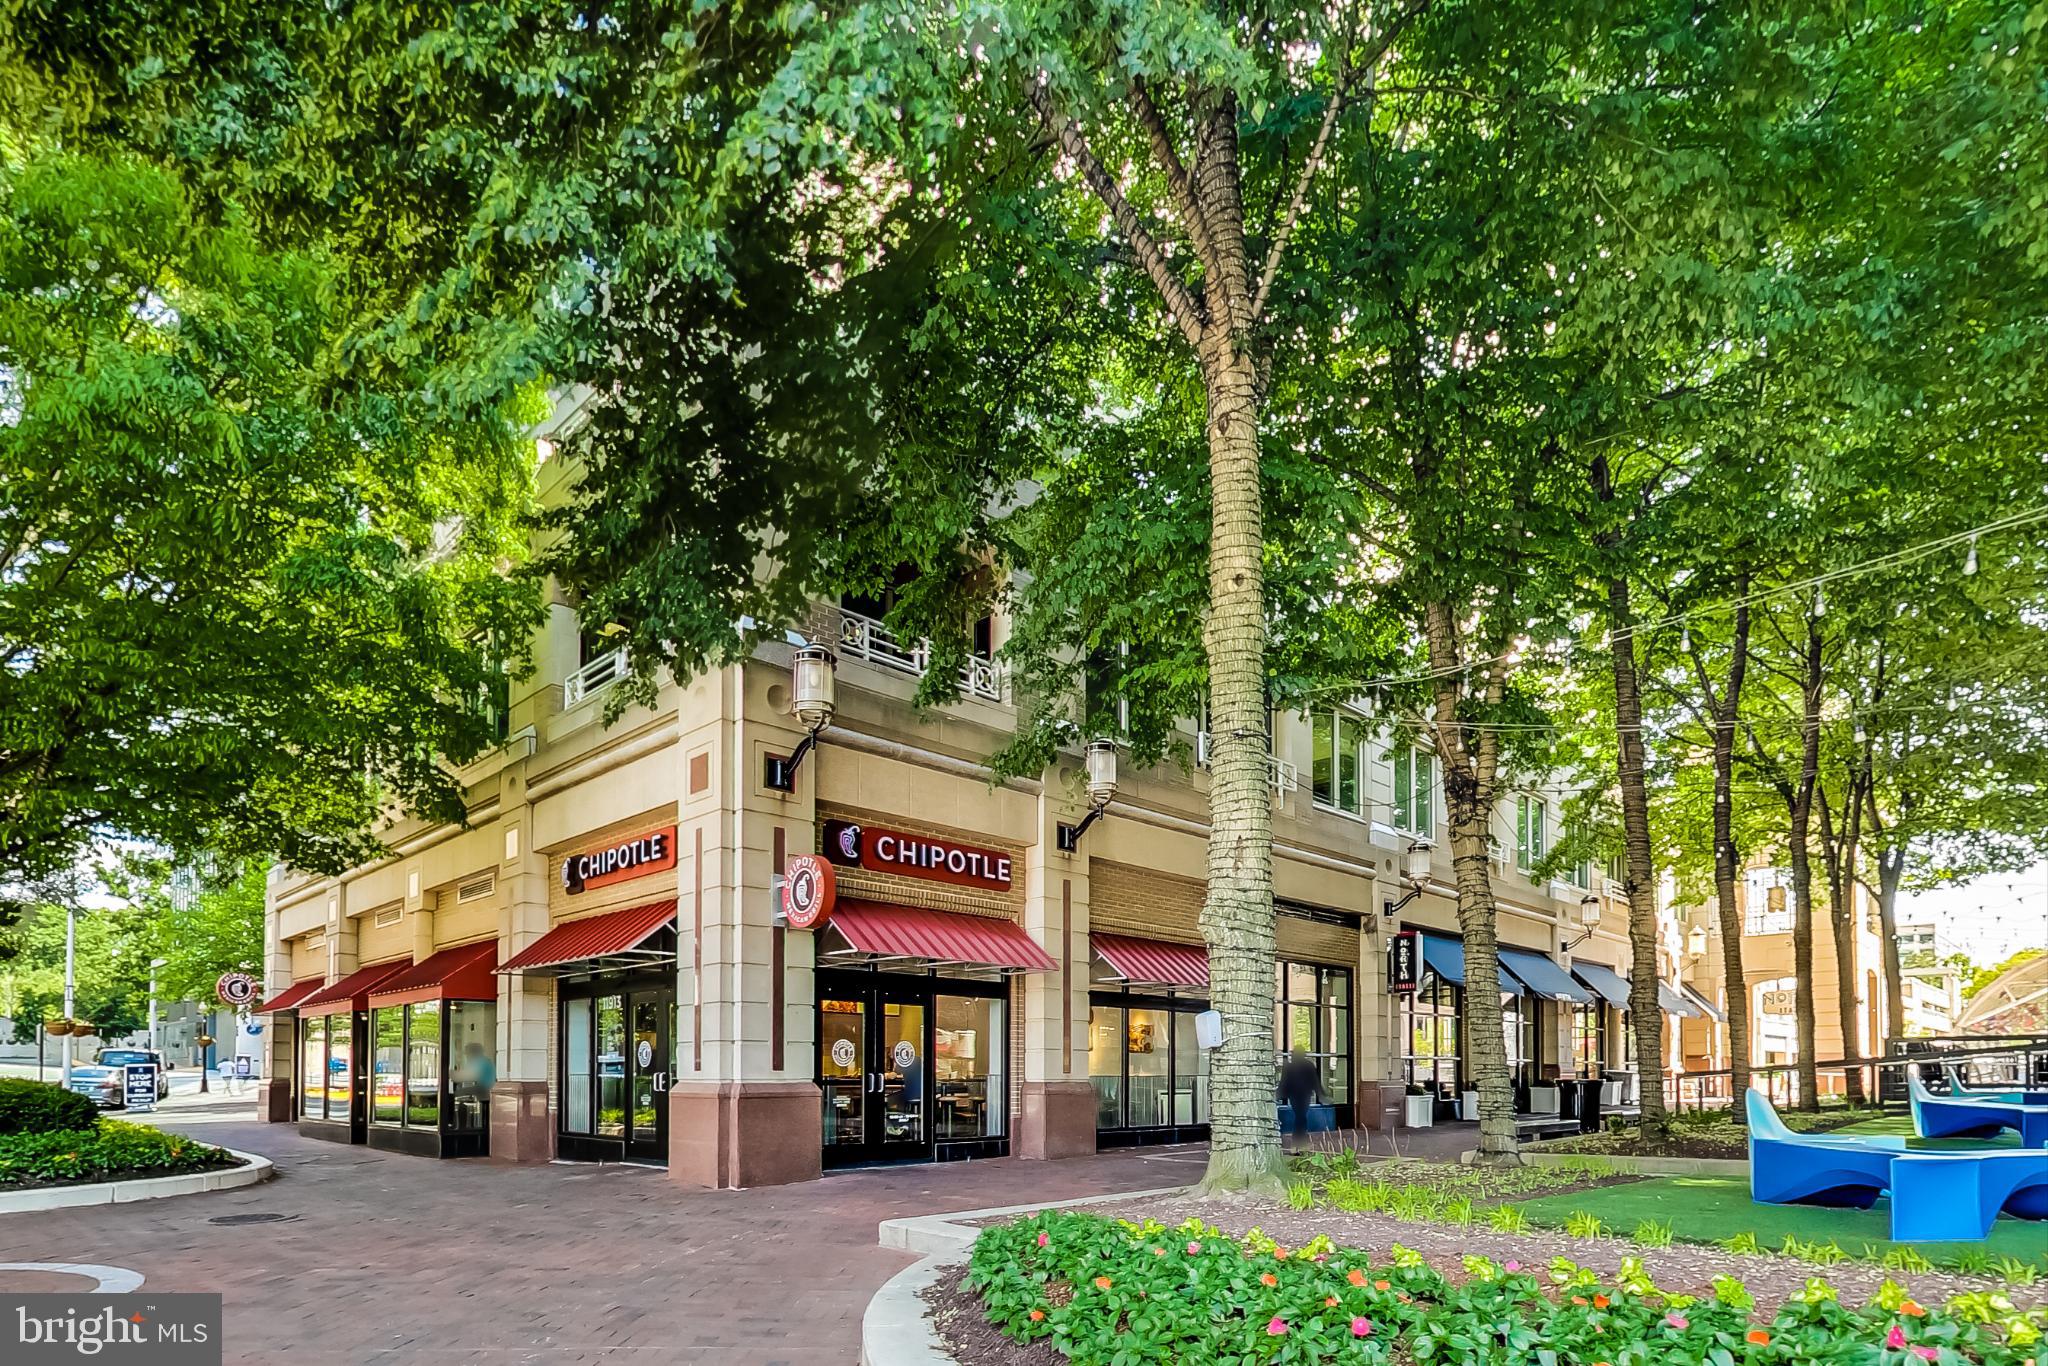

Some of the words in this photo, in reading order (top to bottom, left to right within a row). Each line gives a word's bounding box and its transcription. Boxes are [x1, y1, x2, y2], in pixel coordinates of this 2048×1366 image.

[579, 834, 662, 880] CHIPOTLE
[785, 856, 823, 889] CHIPOTLE
[877, 836, 1011, 881] CHIPOTLE
[786, 902, 809, 923] MEXICAN
[129, 1073, 152, 1081] STOP
